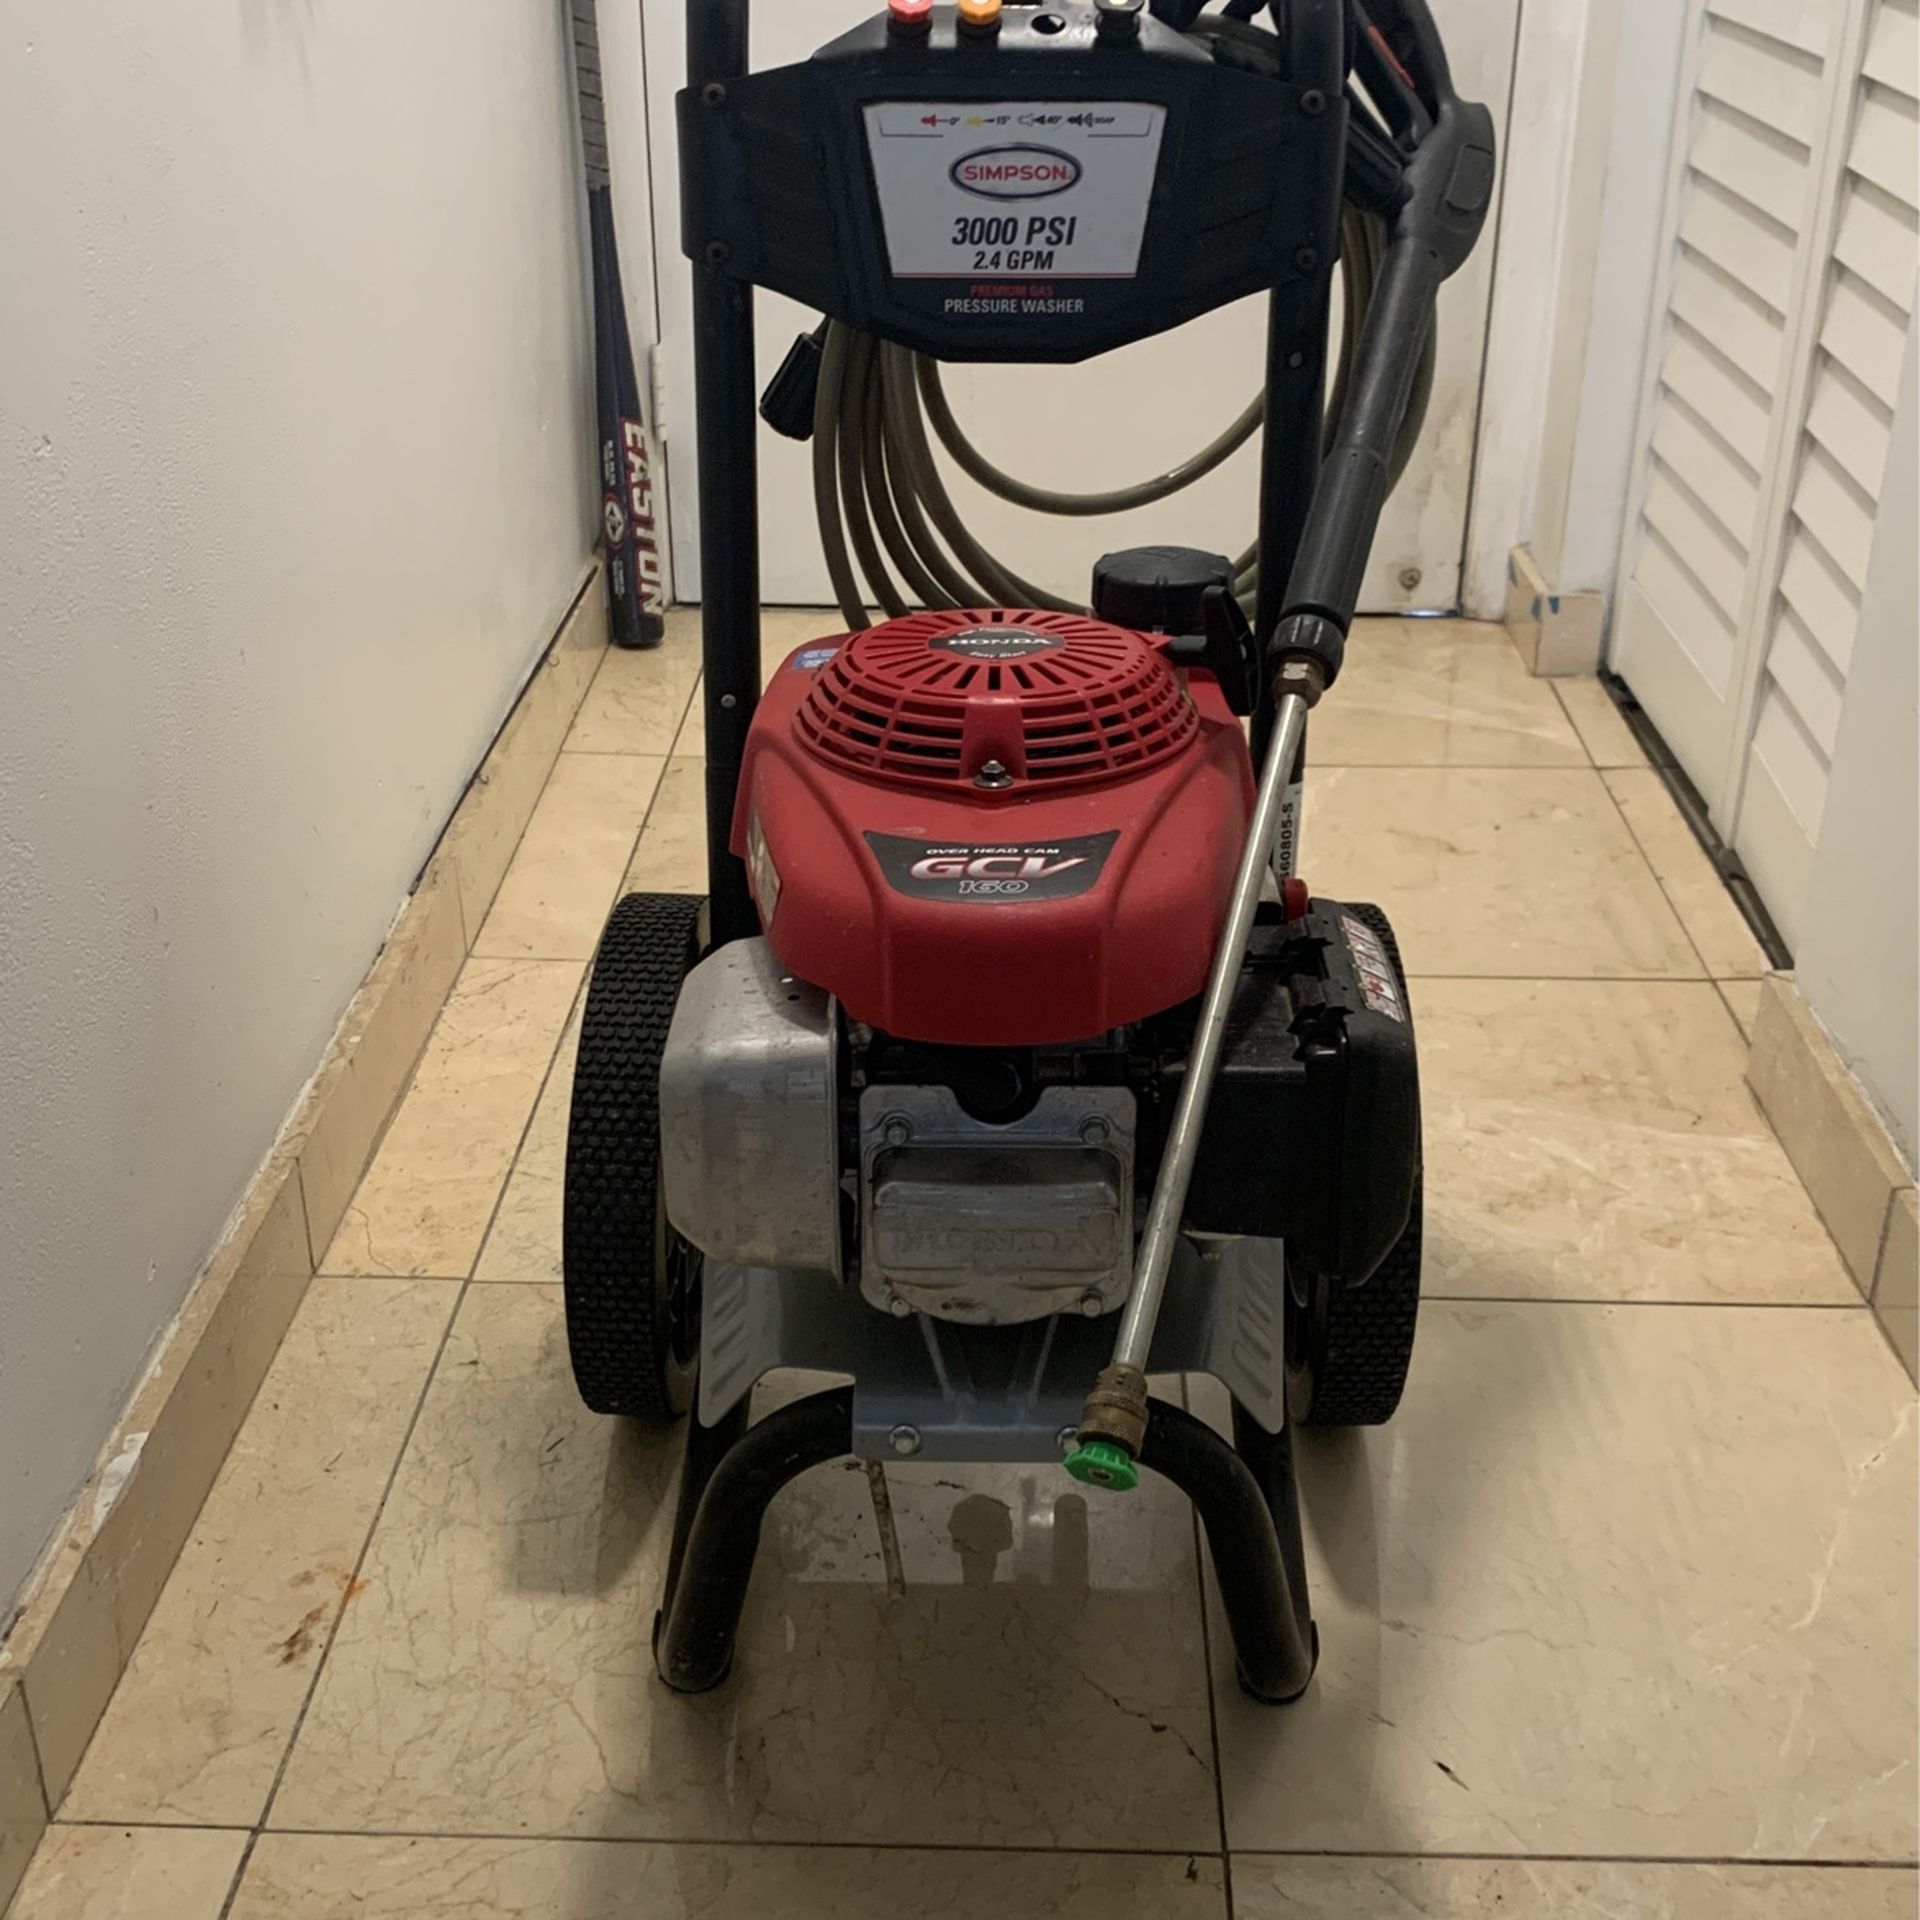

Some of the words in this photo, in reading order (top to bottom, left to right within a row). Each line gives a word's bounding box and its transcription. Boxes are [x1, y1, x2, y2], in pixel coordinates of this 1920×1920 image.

[963, 165, 1067, 181] SIMPSON
[952, 216, 1019, 246] 3000
[1025, 216, 1077, 246] PSI
[973, 250, 1001, 270] 2.4
[1007, 250, 1055, 270] GPM
[970, 285, 1027, 297] PREMIUM
[1029, 285, 1055, 297] GAS
[944, 299, 1018, 314] PRESSURE
[1022, 299, 1085, 314] WASHER
[622, 418, 665, 617] EASTON
[948, 638, 1053, 646] HONDA
[1024, 847, 1060, 855] CAM
[910, 856, 1089, 879] GCV
[959, 879, 1029, 895] 160
